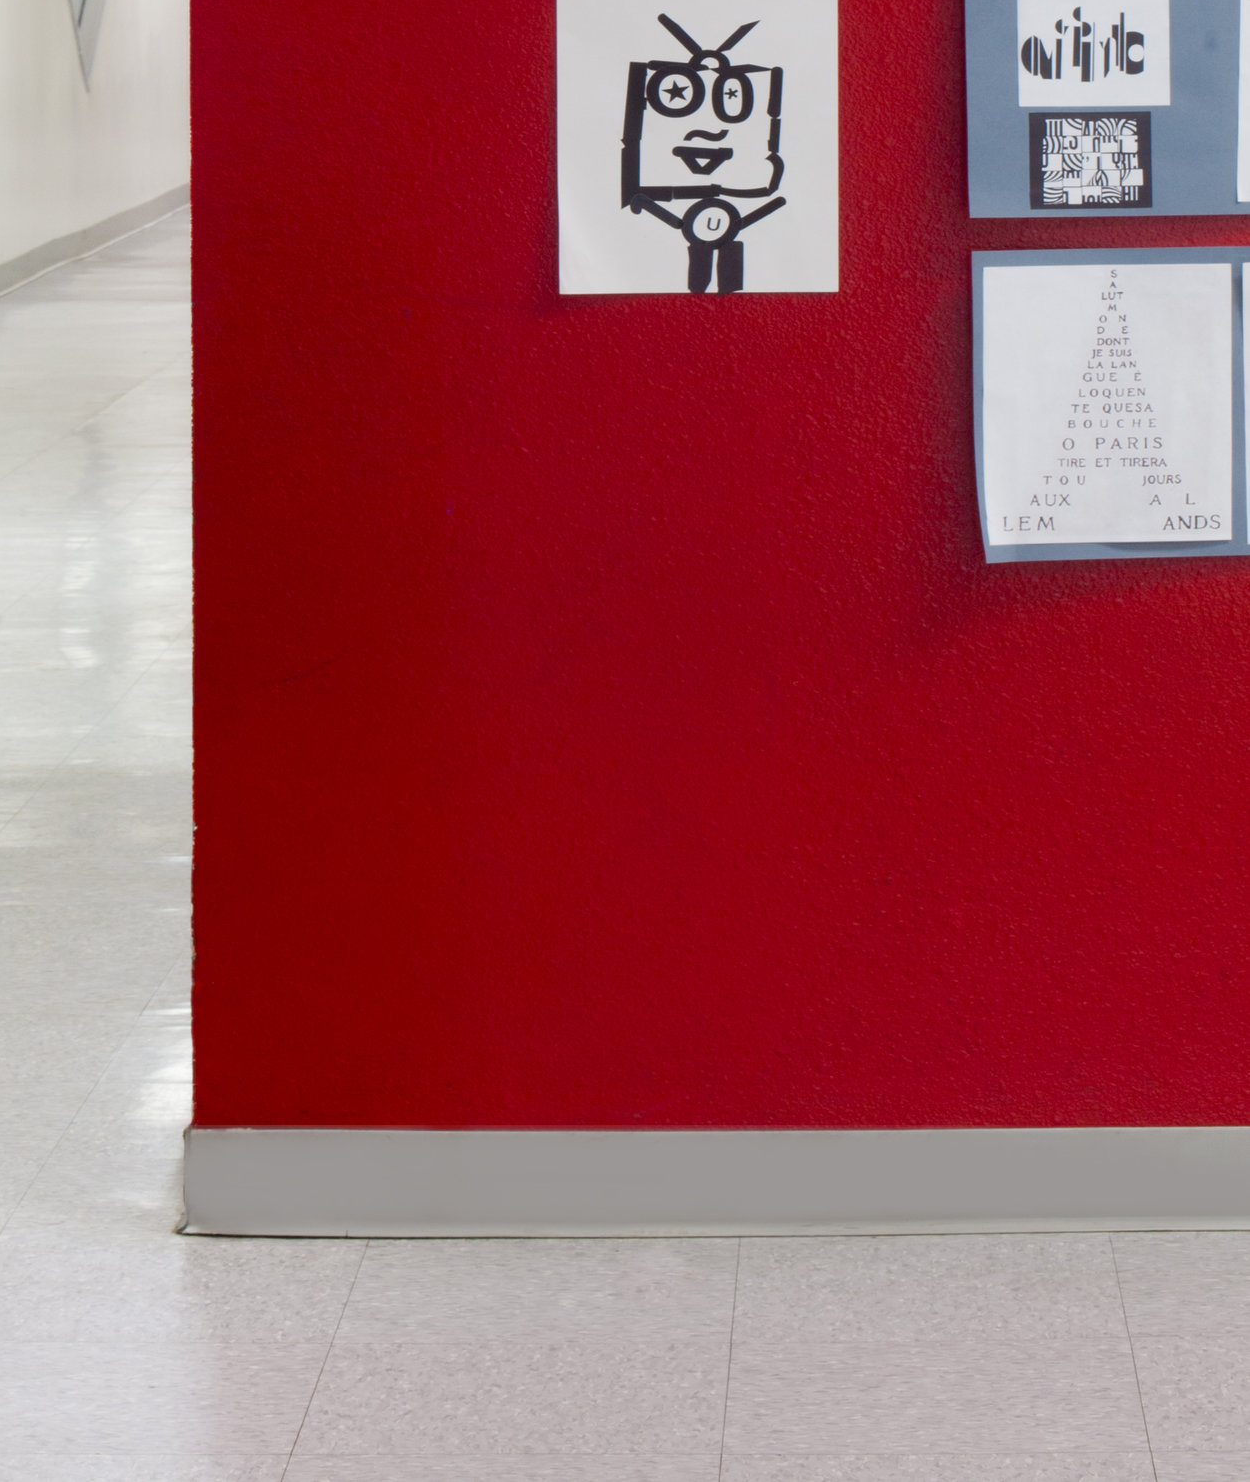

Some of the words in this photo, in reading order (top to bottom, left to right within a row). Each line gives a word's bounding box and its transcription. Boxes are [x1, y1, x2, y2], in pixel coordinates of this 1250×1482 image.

[1101, 291, 1124, 301] LUT
[1097, 337, 1130, 346] DONT
[1091, 348, 1103, 359] JE
[1108, 348, 1132, 358] SUIS
[1087, 359, 1104, 369] LA
[1110, 359, 1137, 369] LAN
[1082, 371, 1118, 383] GUE
[1078, 387, 1147, 399] LOQUEN
[1071, 403, 1090, 414] TE
[1067, 418, 1158, 429] BOUCHE
[1062, 437, 1076, 451] O
[1094, 436, 1164, 450] PARIS
[1057, 457, 1087, 468] TIRE
[1094, 457, 1112, 468] ET
[1120, 456, 1168, 468] TIRERA
[1042, 475, 1087, 486] TOU
[1141, 473, 1183, 487] JOURS
[1029, 493, 1072, 507] AUX
[1002, 515, 1056, 532] LEM
[1162, 514, 1222, 531] ANDS
